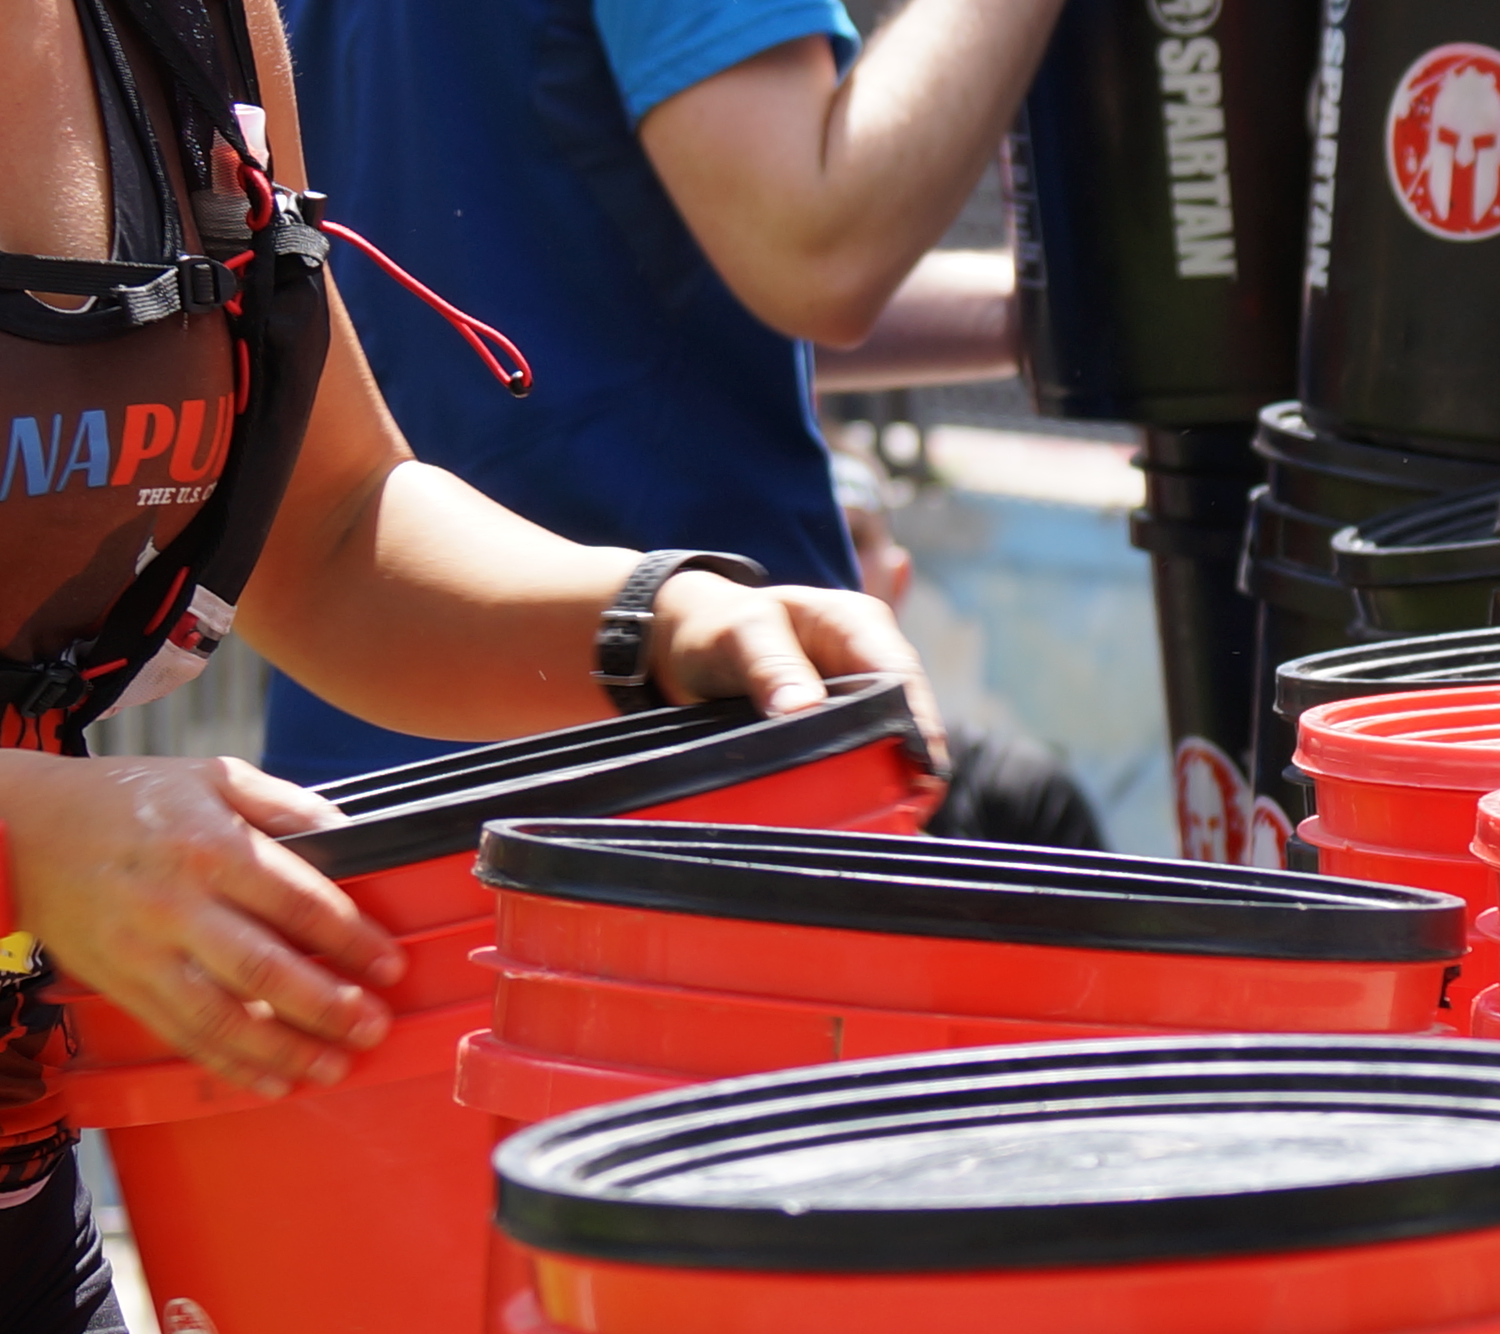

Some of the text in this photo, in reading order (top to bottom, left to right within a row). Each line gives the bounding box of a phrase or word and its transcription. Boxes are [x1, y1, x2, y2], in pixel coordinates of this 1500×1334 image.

[1156, 35, 1239, 281] SPARTAN
[1308, 27, 1347, 289] SPARTAN
[137, 487, 176, 506] THE
